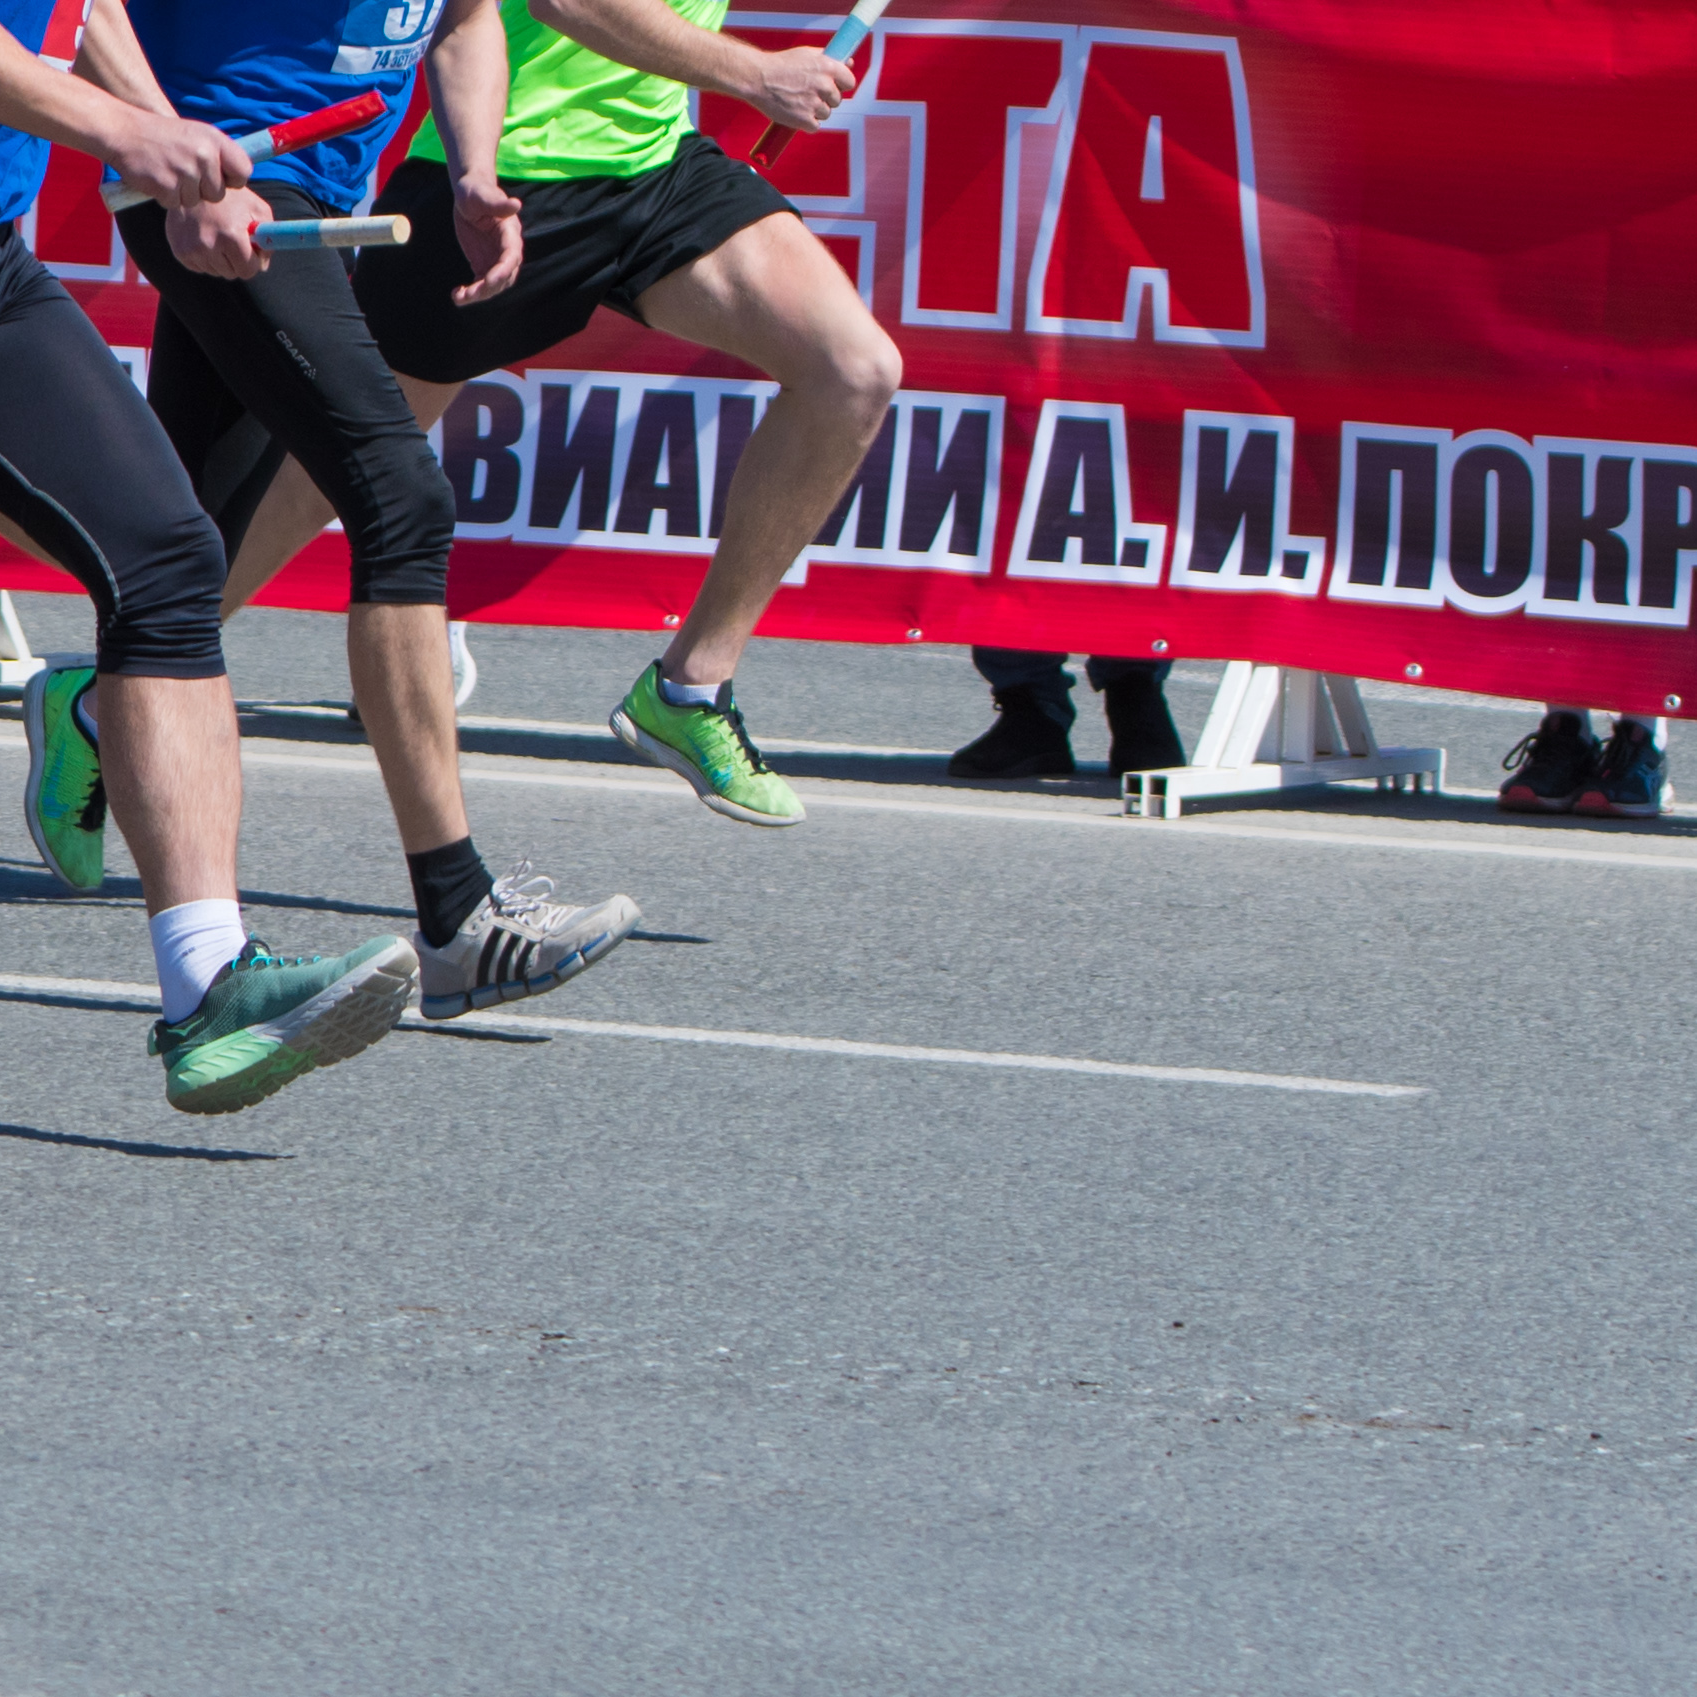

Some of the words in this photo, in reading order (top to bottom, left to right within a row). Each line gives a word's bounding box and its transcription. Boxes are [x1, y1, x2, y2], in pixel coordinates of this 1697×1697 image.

[372, 50, 391, 70] 74
[276, 330, 310, 368] CRAFT
[1015, 406, 1159, 576] А.
[1178, 416, 1318, 588] И.
